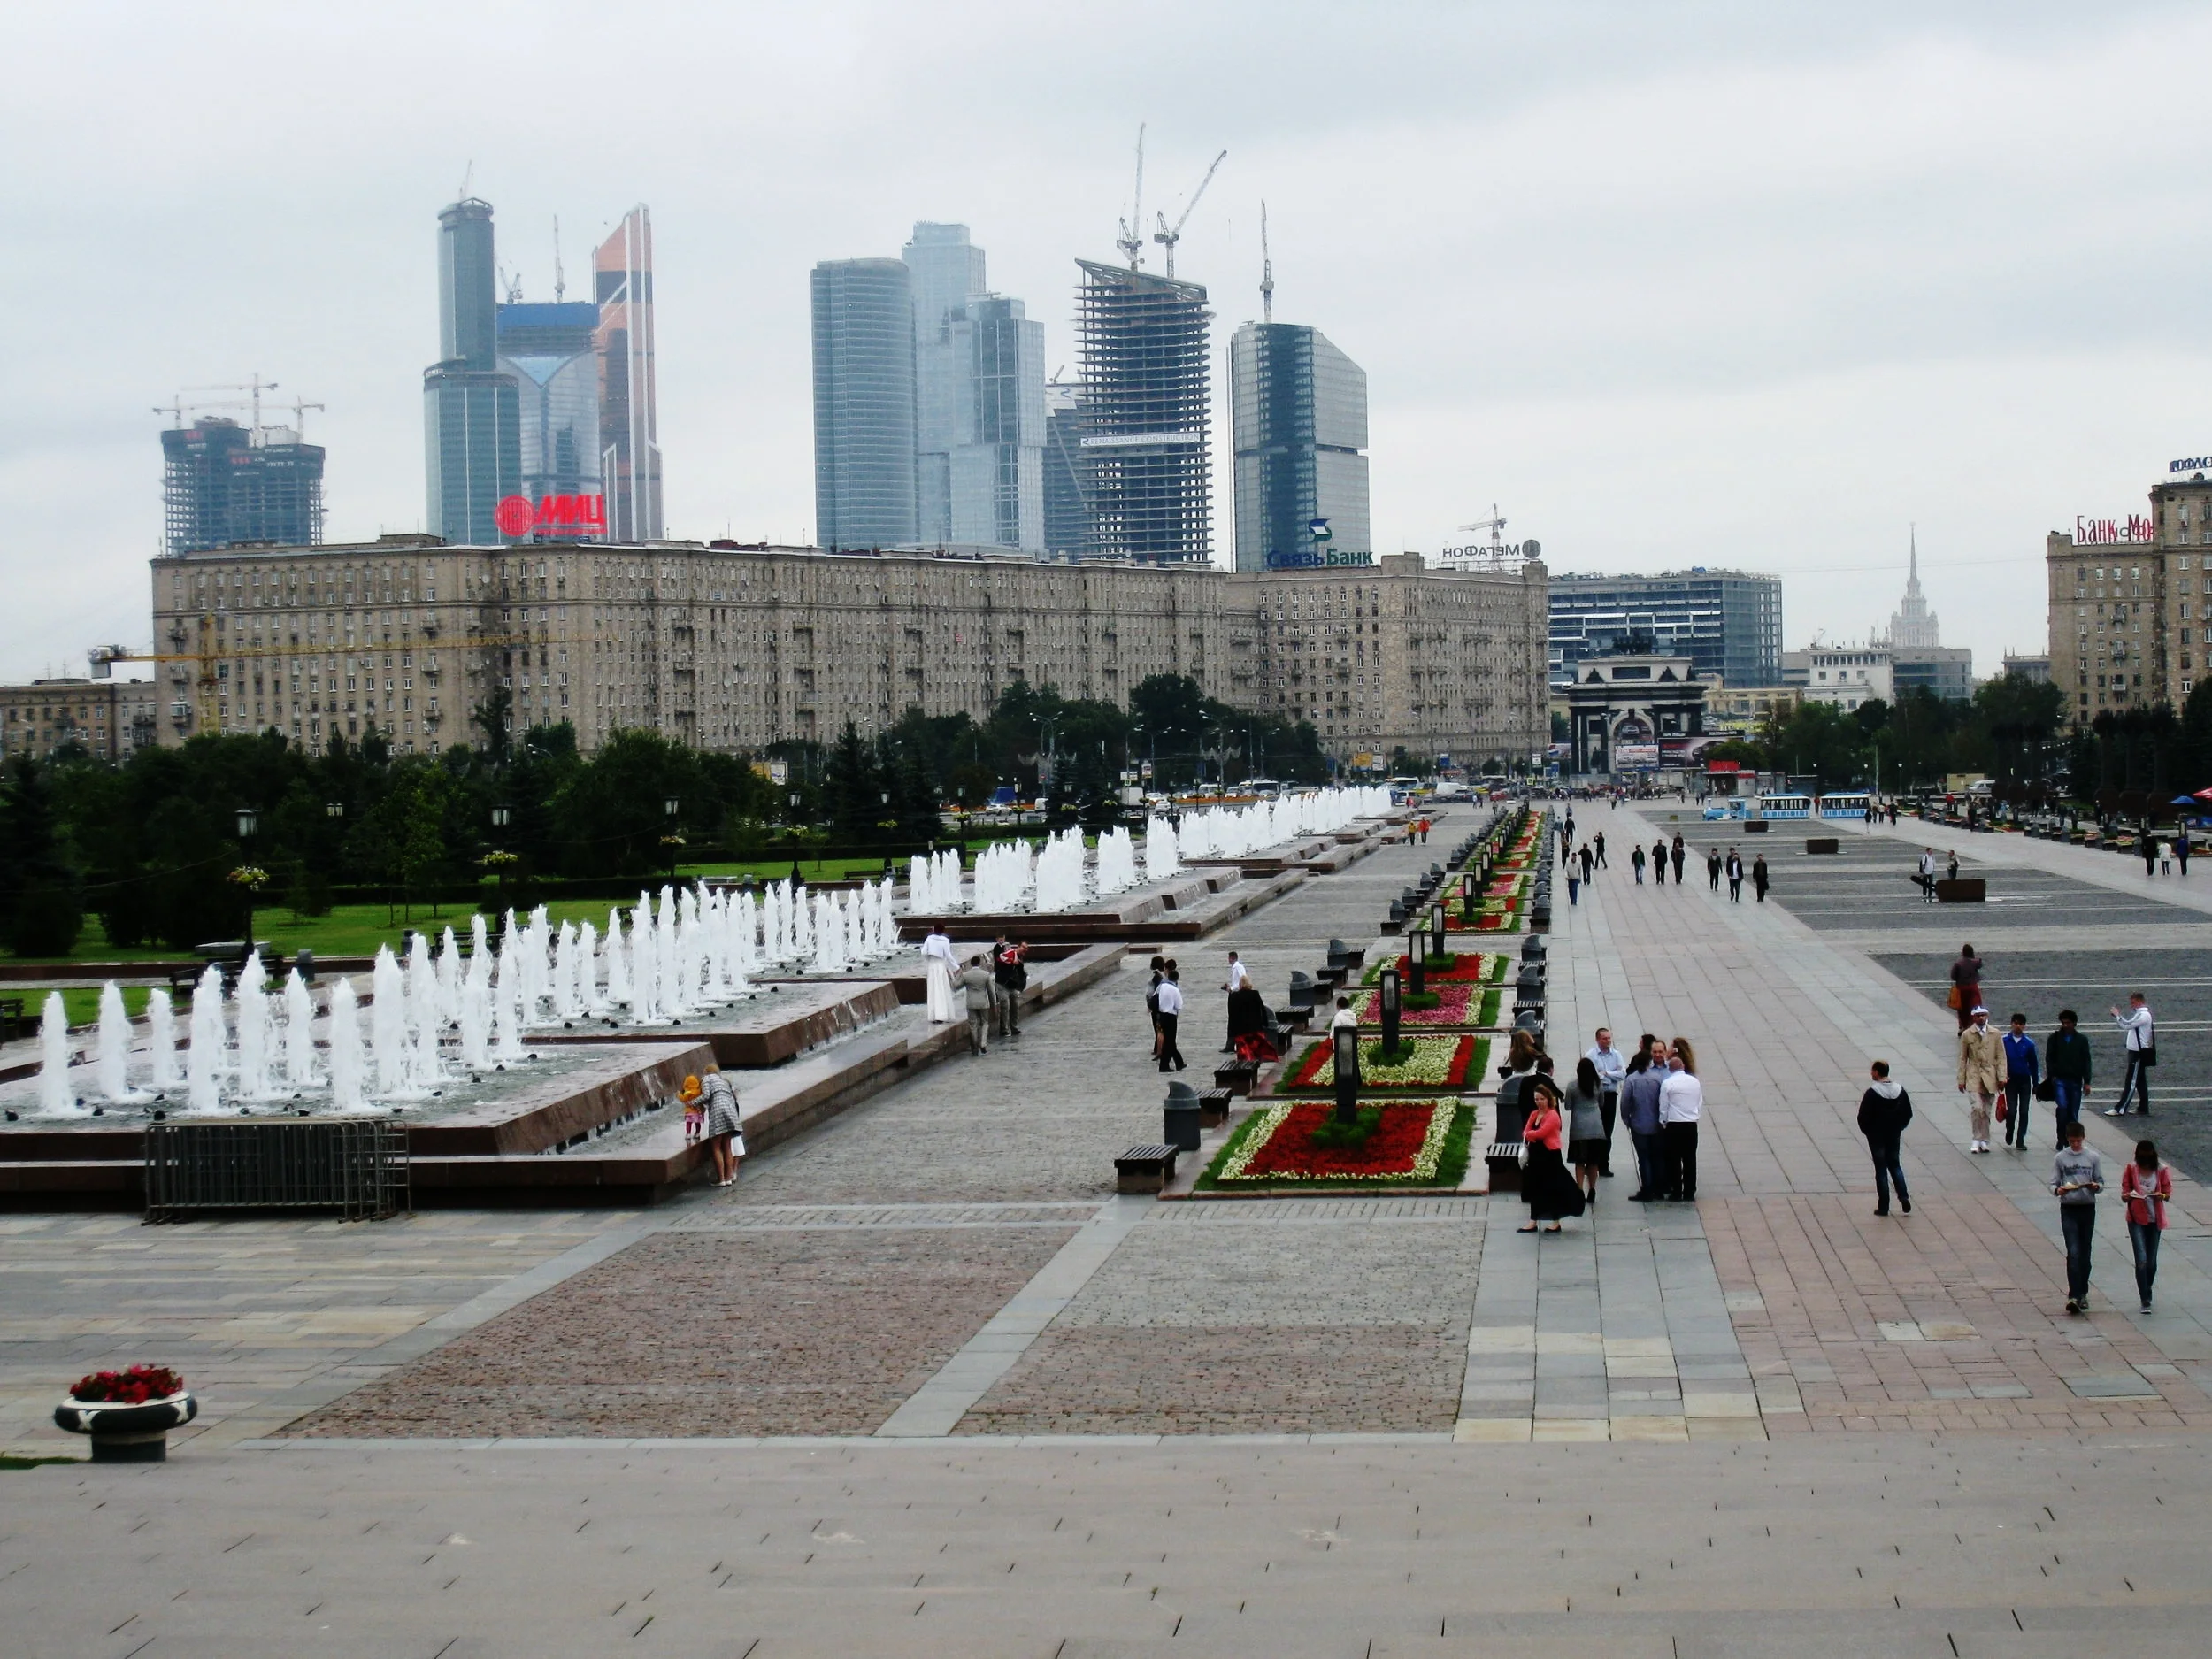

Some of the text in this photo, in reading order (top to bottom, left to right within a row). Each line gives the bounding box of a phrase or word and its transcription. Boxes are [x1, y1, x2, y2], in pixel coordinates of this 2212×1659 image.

[1141, 433, 1199, 443] CONSTRUCTION
[534, 494, 606, 525] МИЦ
[2077, 515, 2117, 543] Банк
[2127, 514, 2153, 541] Мо
